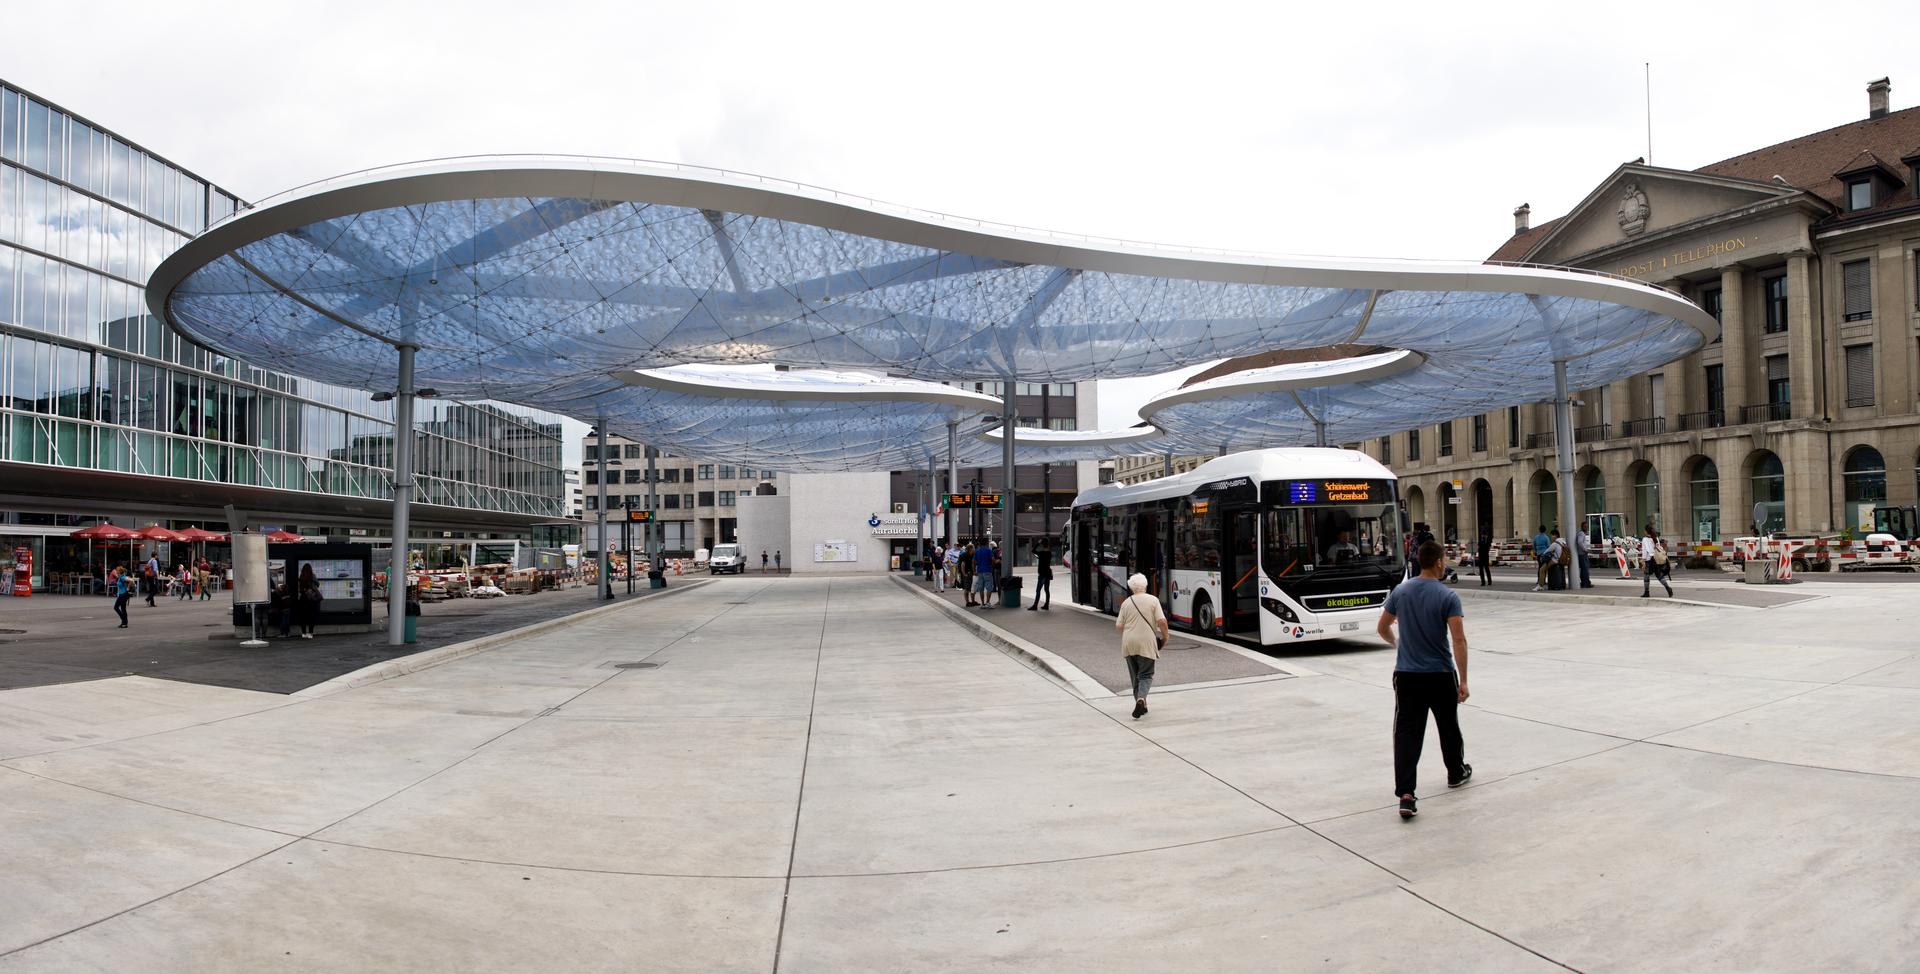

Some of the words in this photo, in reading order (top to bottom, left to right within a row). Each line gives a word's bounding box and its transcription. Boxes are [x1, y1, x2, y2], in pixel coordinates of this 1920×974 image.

[1620, 260, 1654, 277] POST
[1671, 237, 1746, 265] TELEPHON
[1324, 482, 1371, 491] Schönenwerd-
[1328, 492, 1369, 501] Gretzenbach
[871, 527, 919, 535] Aarauerho
[1326, 595, 1370, 607] ökologisch
